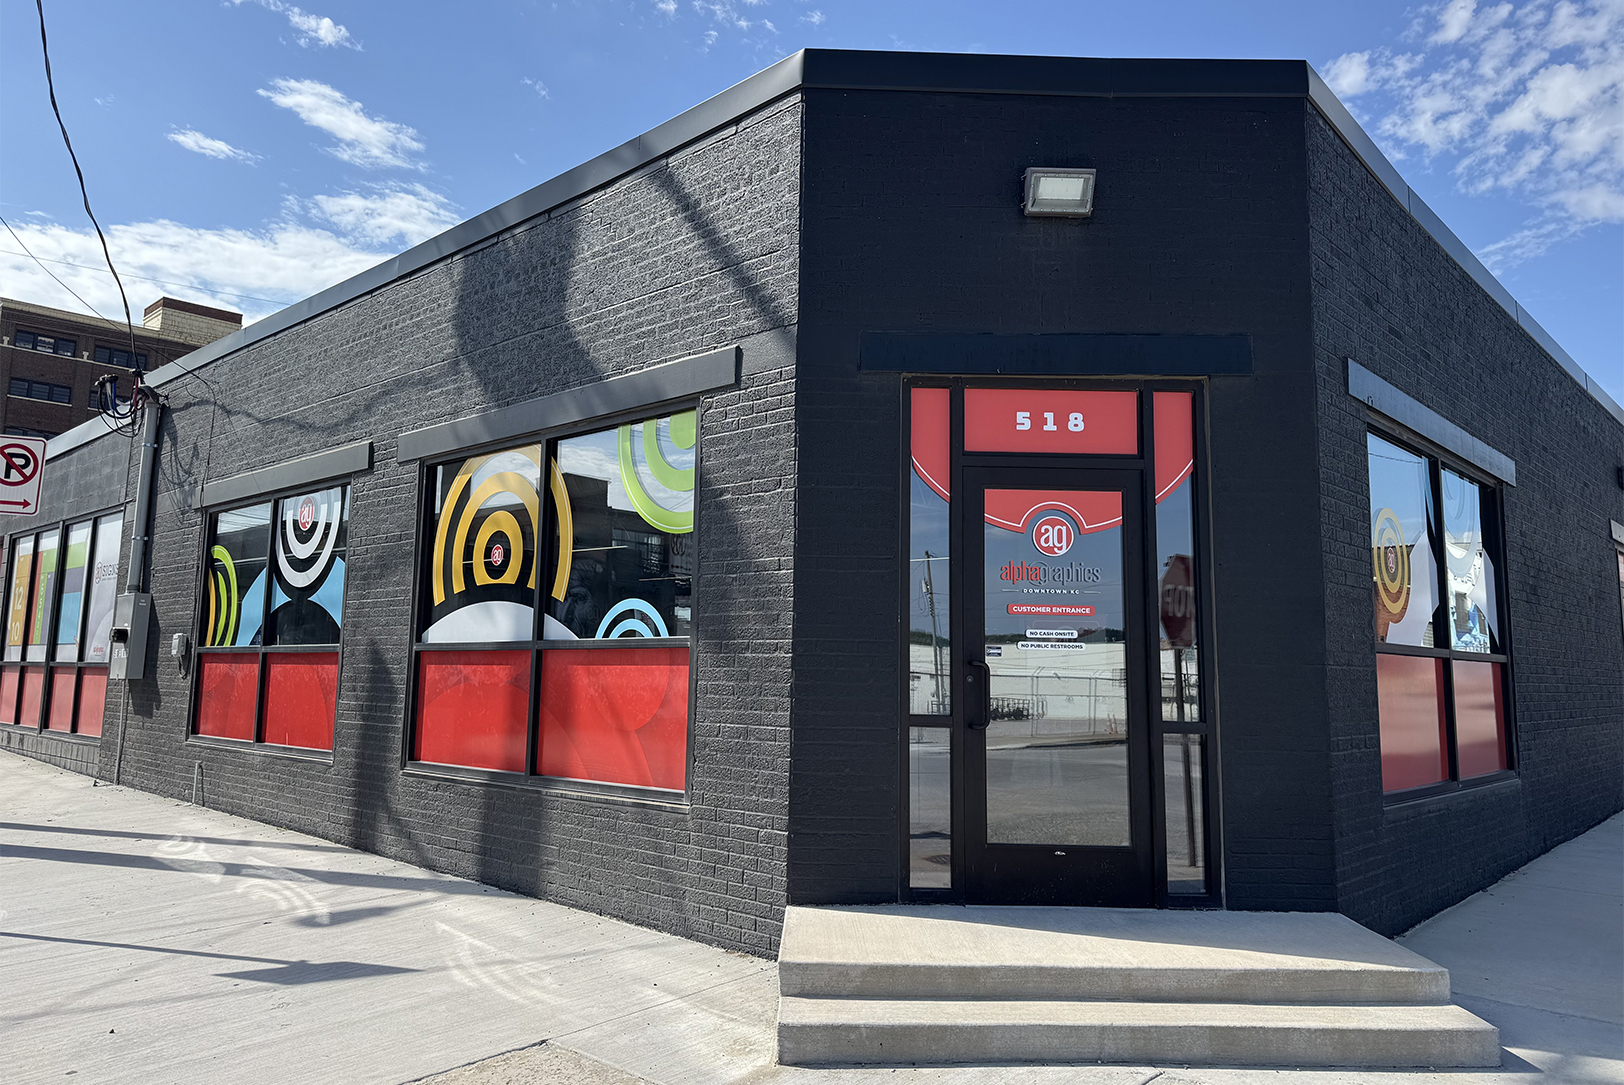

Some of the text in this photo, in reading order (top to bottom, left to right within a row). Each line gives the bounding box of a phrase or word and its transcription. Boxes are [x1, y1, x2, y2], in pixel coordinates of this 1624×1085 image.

[1016, 411, 1085, 432] 518
[301, 503, 312, 528] ag
[1040, 525, 1067, 554] ag
[1000, 560, 1102, 586] alphagraphics
[15, 586, 24, 610] 12
[1012, 605, 1091, 614] CUSTOMER ENTRANCE
[11, 621, 20, 641] 10
